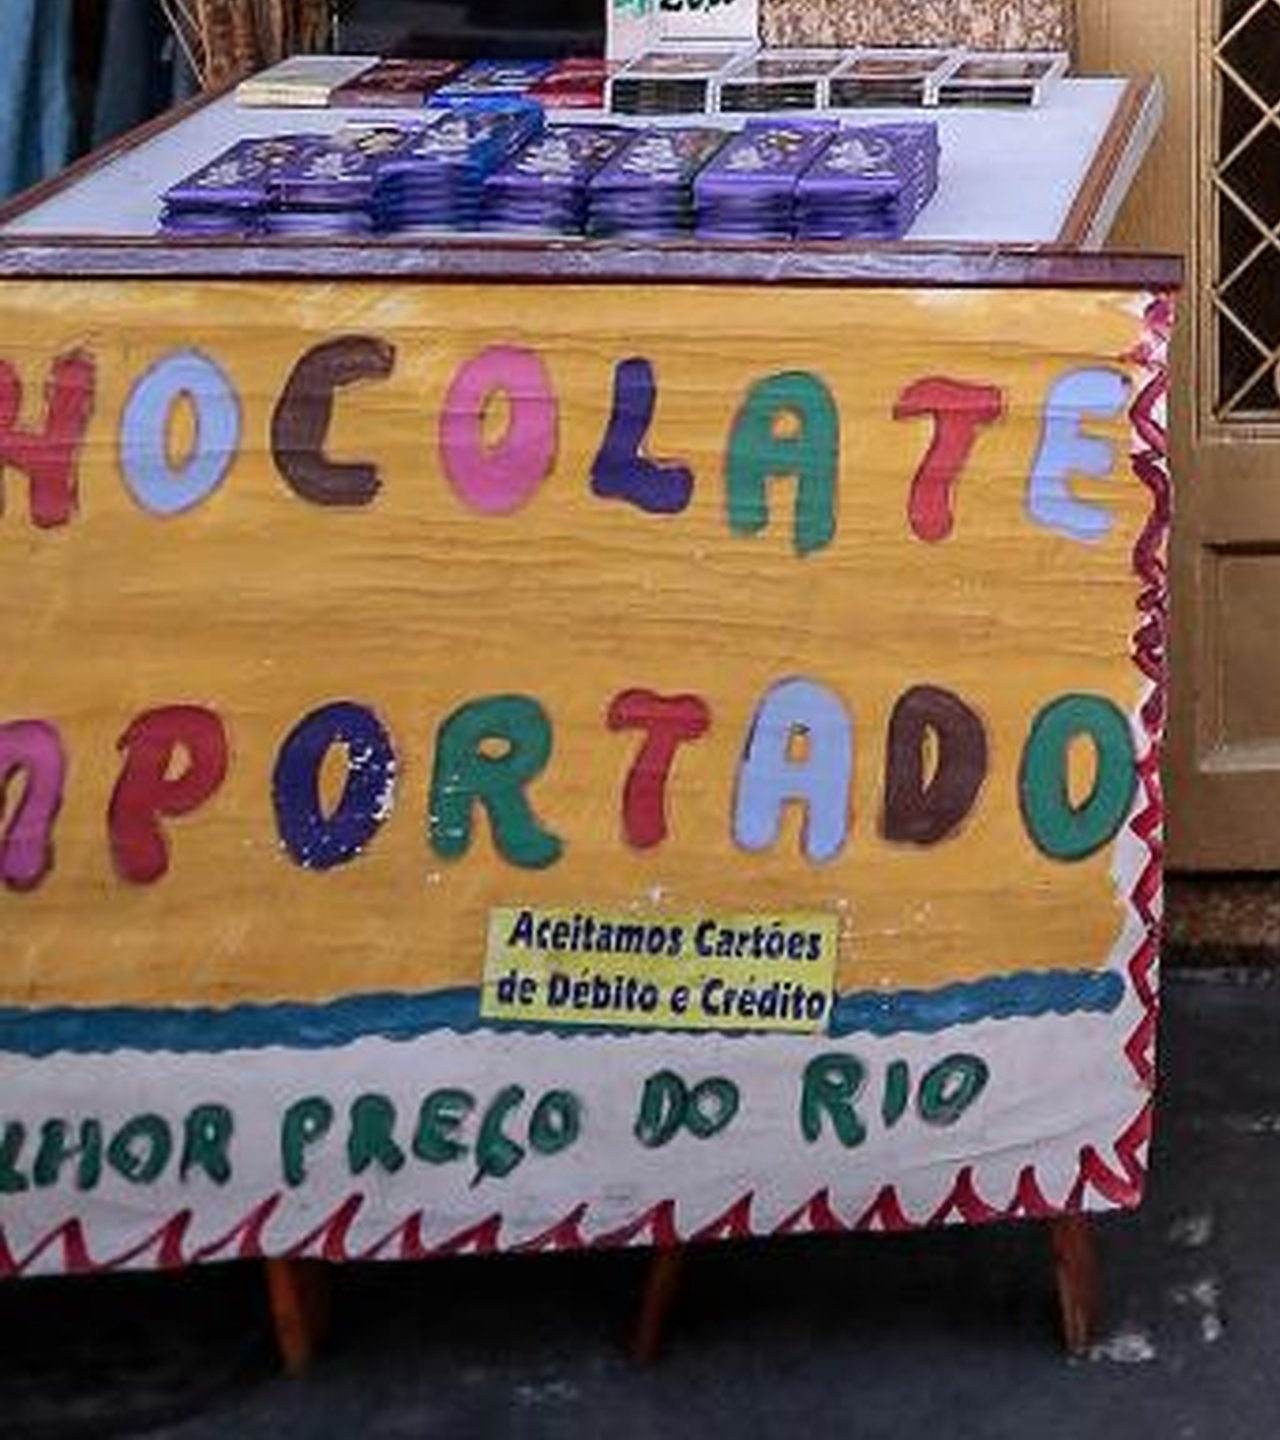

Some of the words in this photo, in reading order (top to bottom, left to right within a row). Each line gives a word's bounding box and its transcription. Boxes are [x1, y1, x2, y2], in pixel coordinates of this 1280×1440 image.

[507, 910, 683, 958] Aceitamos
[694, 919, 823, 961] Cartões
[496, 969, 537, 1006] de
[546, 967, 660, 1014] Débito
[669, 984, 691, 1015] e
[700, 975, 827, 1022] Crédito
[279, 1082, 585, 1187] PREÇO
[633, 1067, 741, 1150] DO
[799, 1050, 992, 1148] RIO
